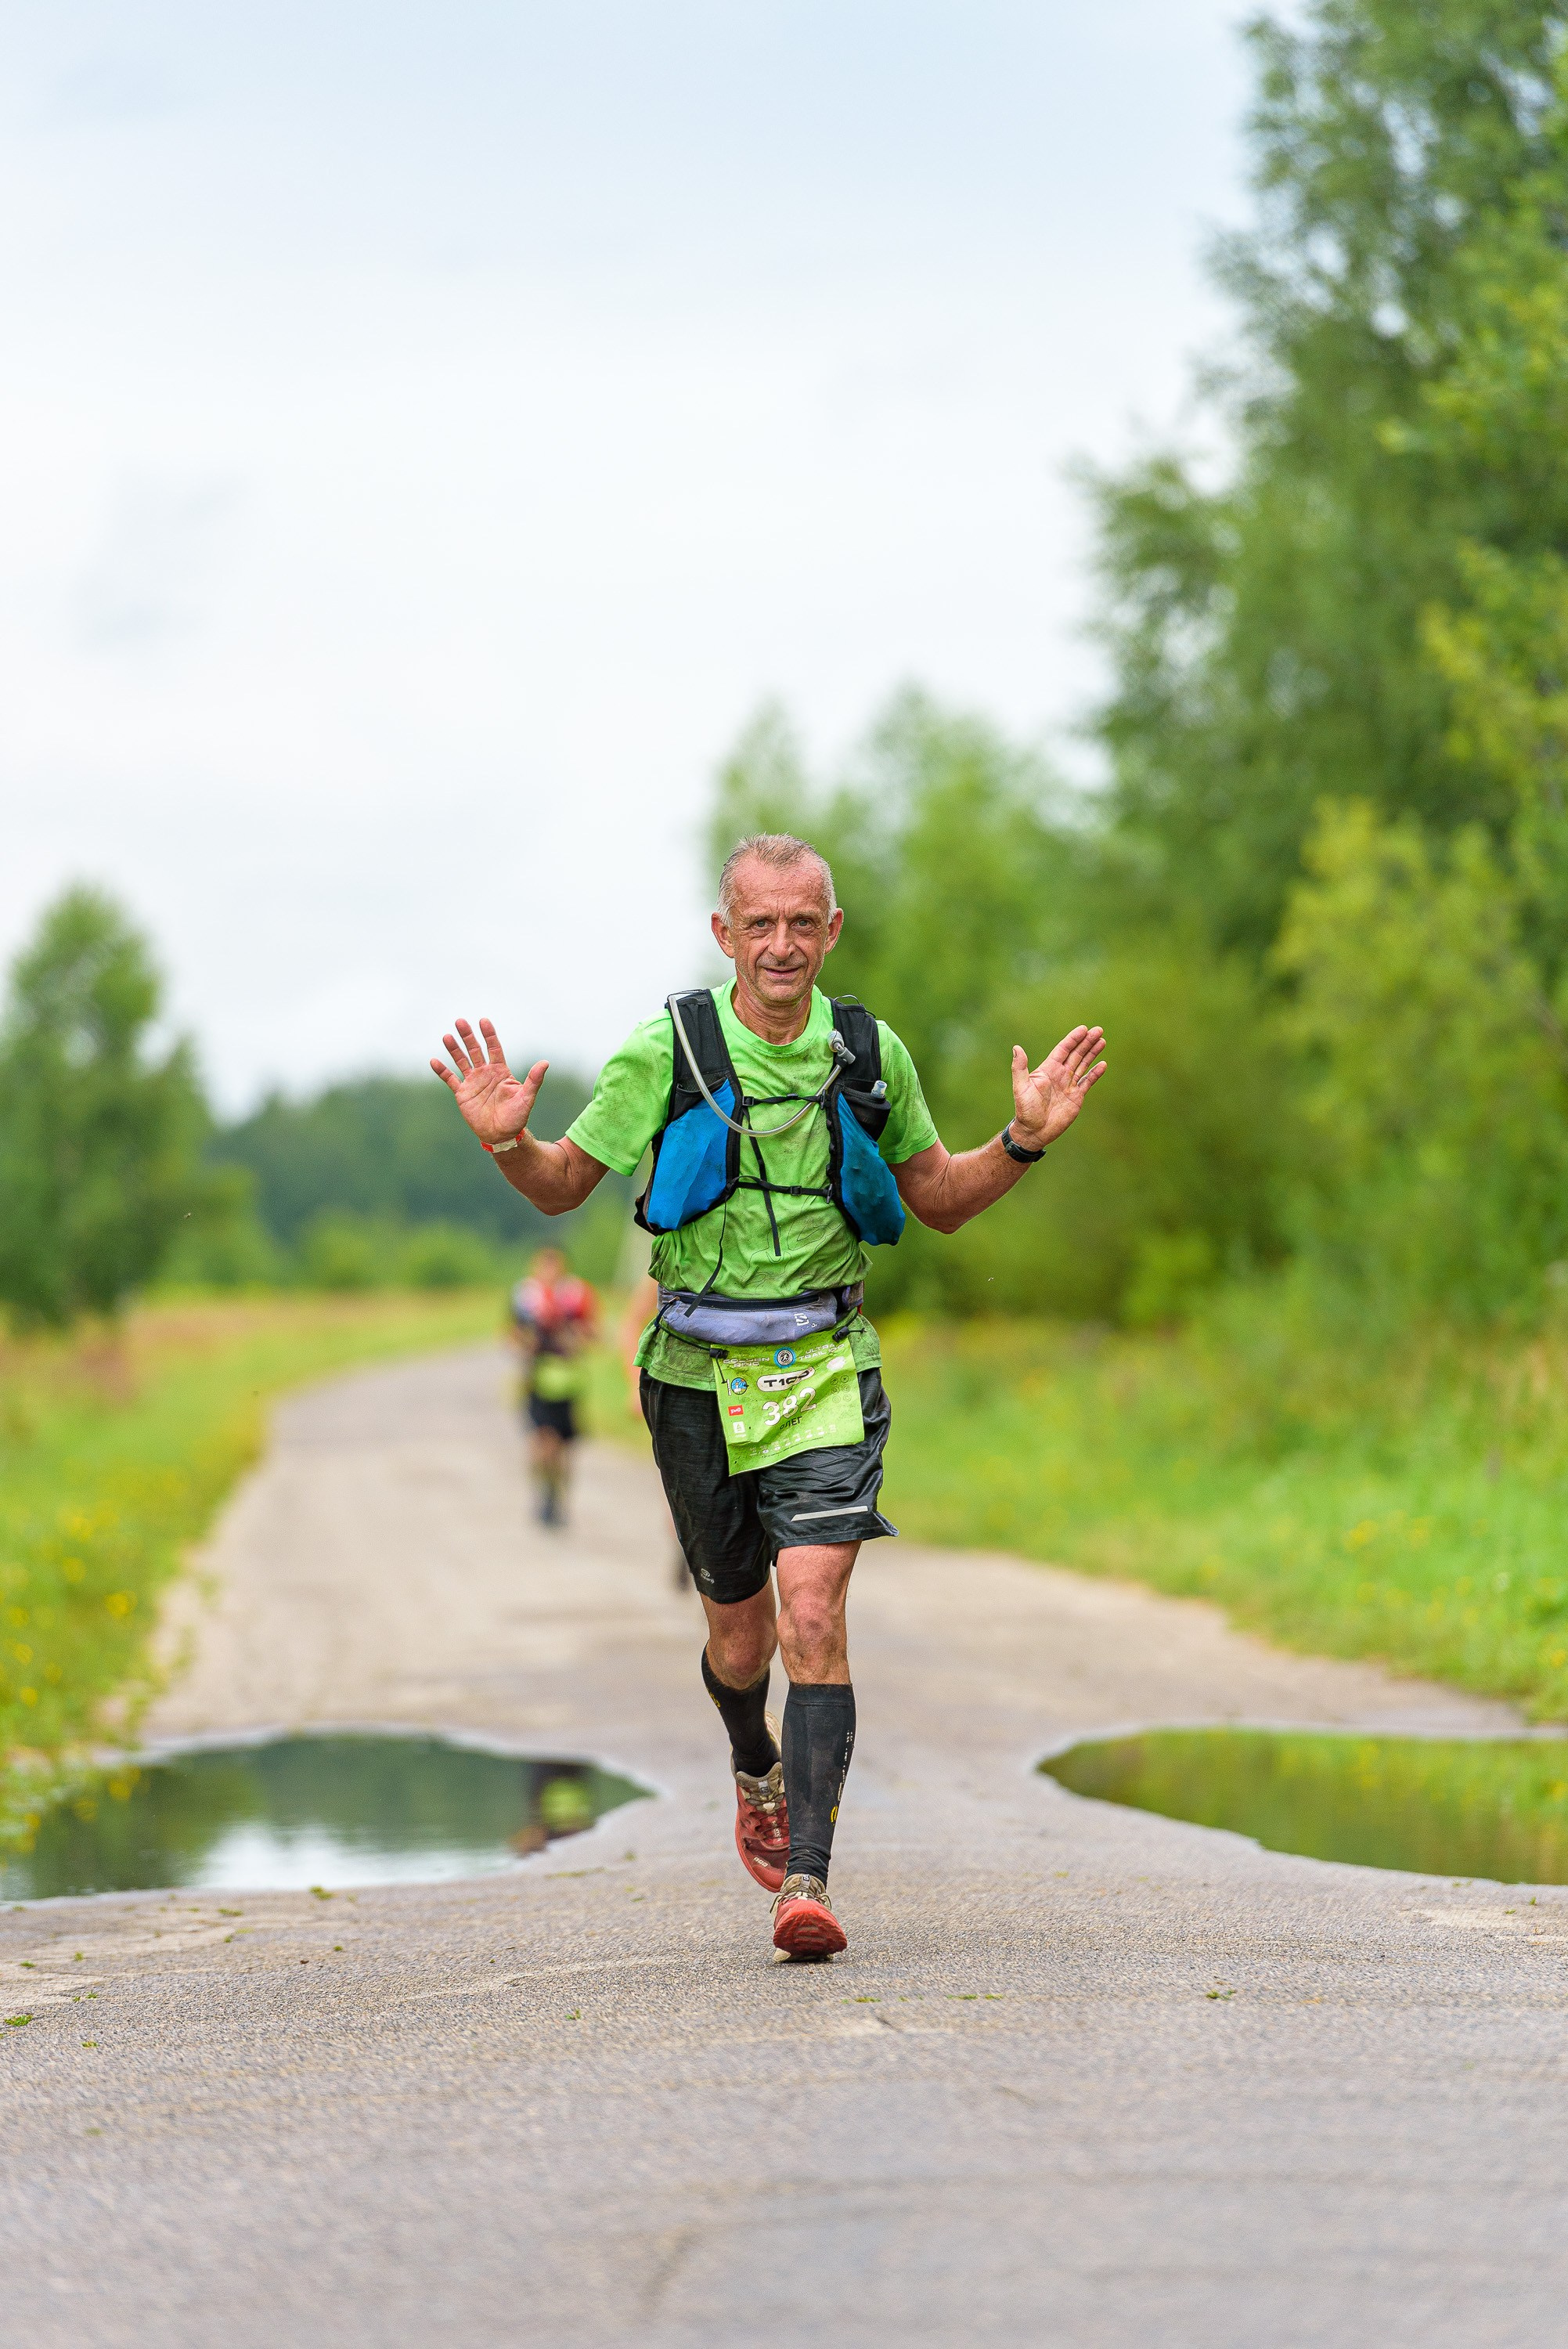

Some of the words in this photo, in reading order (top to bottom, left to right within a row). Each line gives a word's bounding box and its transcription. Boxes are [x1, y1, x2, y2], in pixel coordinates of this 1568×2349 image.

[799, 1351, 827, 1361] TRAIL
[828, 1344, 845, 1353] 100
[806, 1343, 835, 1354] ULTRA
[763, 1370, 810, 1387] T100
[762, 1387, 817, 1426] 382
